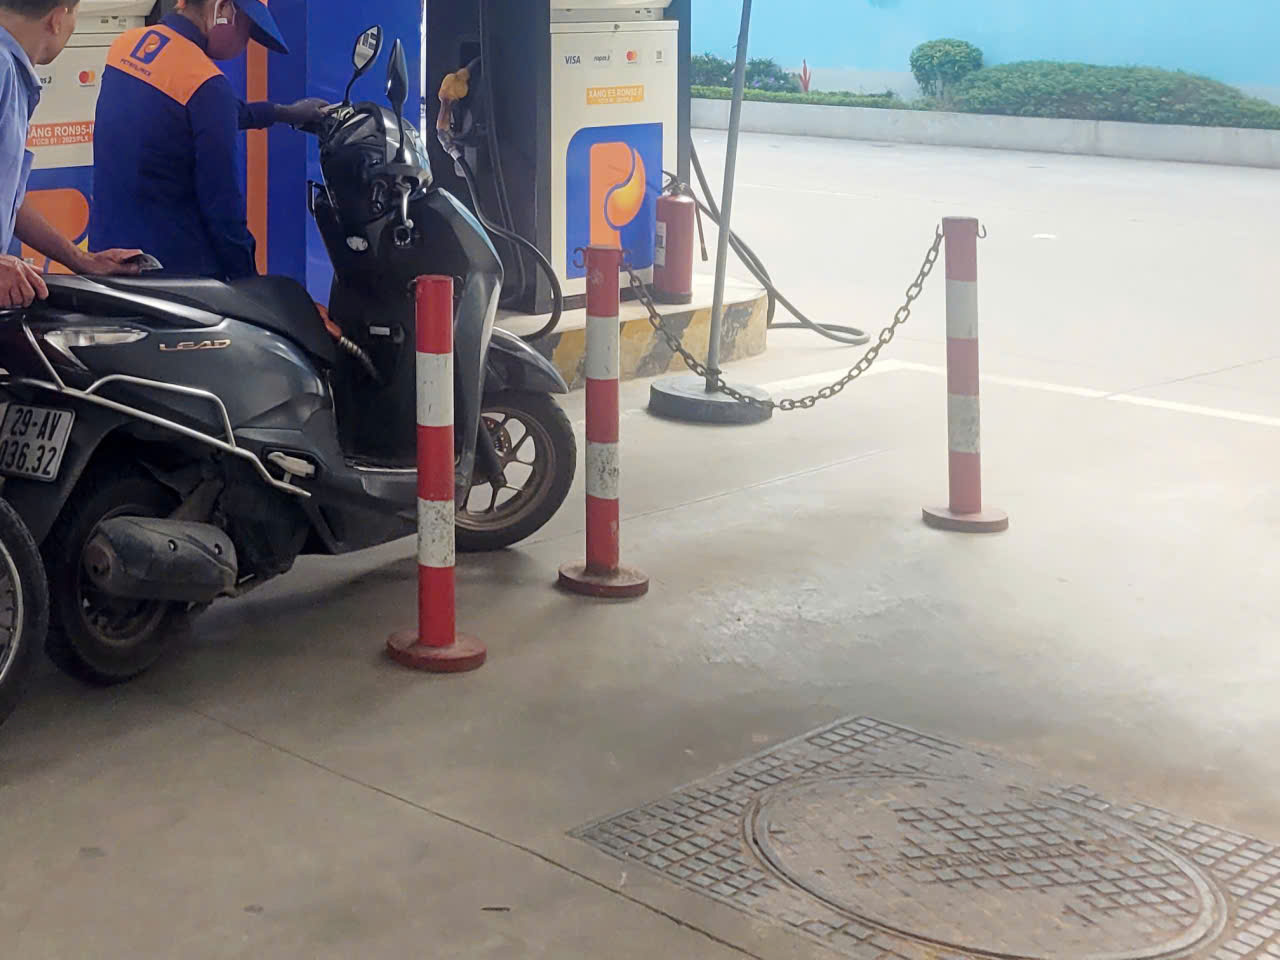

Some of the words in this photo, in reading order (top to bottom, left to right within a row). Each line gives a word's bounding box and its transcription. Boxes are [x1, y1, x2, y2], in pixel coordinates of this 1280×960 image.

[564, 55, 581, 64] VISA
[29, 125, 52, 138] ĂNG
[159, 338, 231, 352] LEAD
[10, 408, 61, 441] 29-AV
